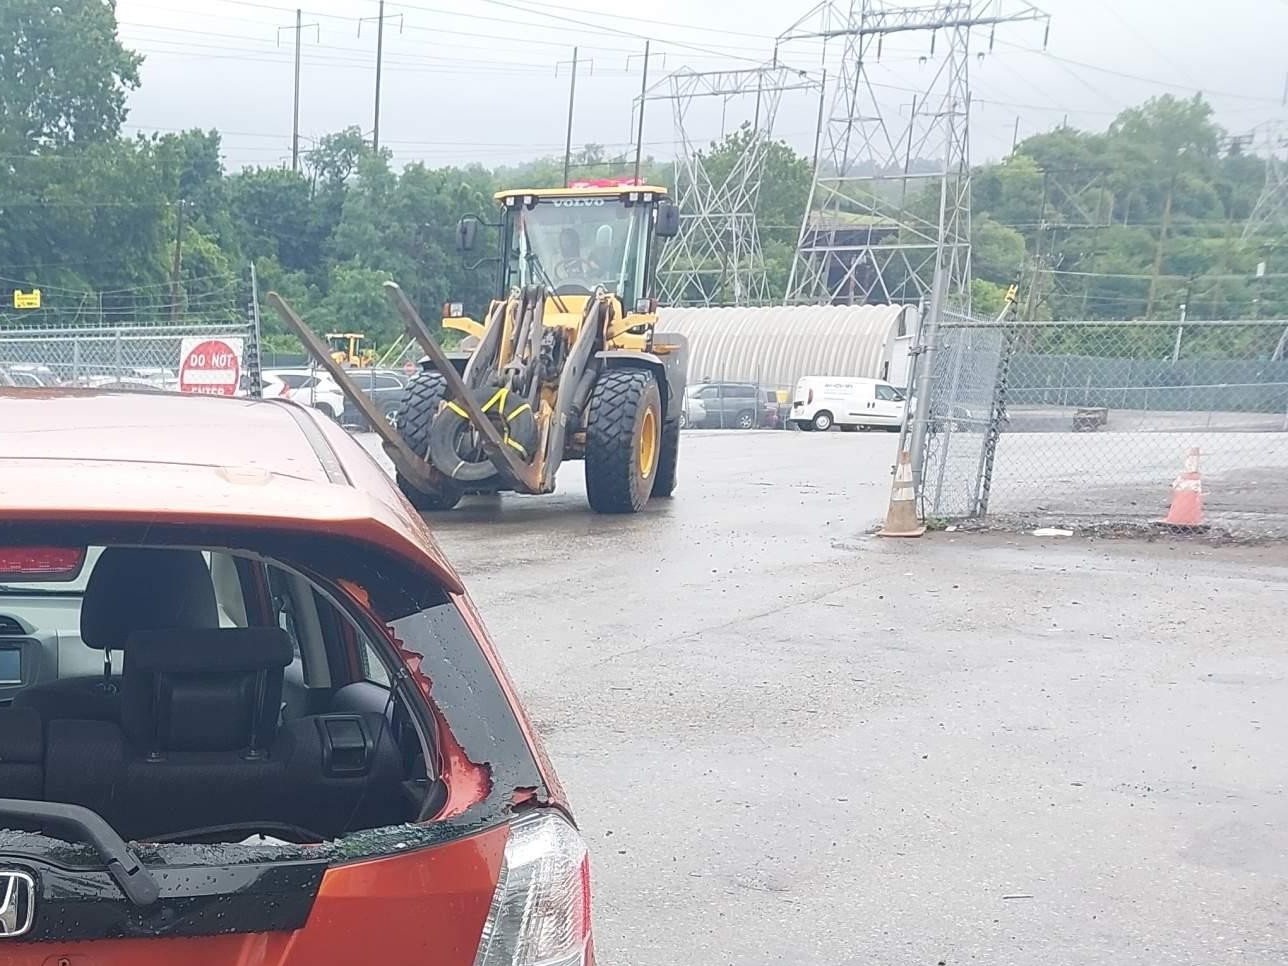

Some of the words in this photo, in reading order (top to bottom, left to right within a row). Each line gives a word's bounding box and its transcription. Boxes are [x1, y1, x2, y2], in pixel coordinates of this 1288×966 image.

[553, 198, 605, 207] VOLVO
[190, 353, 206, 367] DO
[212, 352, 233, 368] NOT
